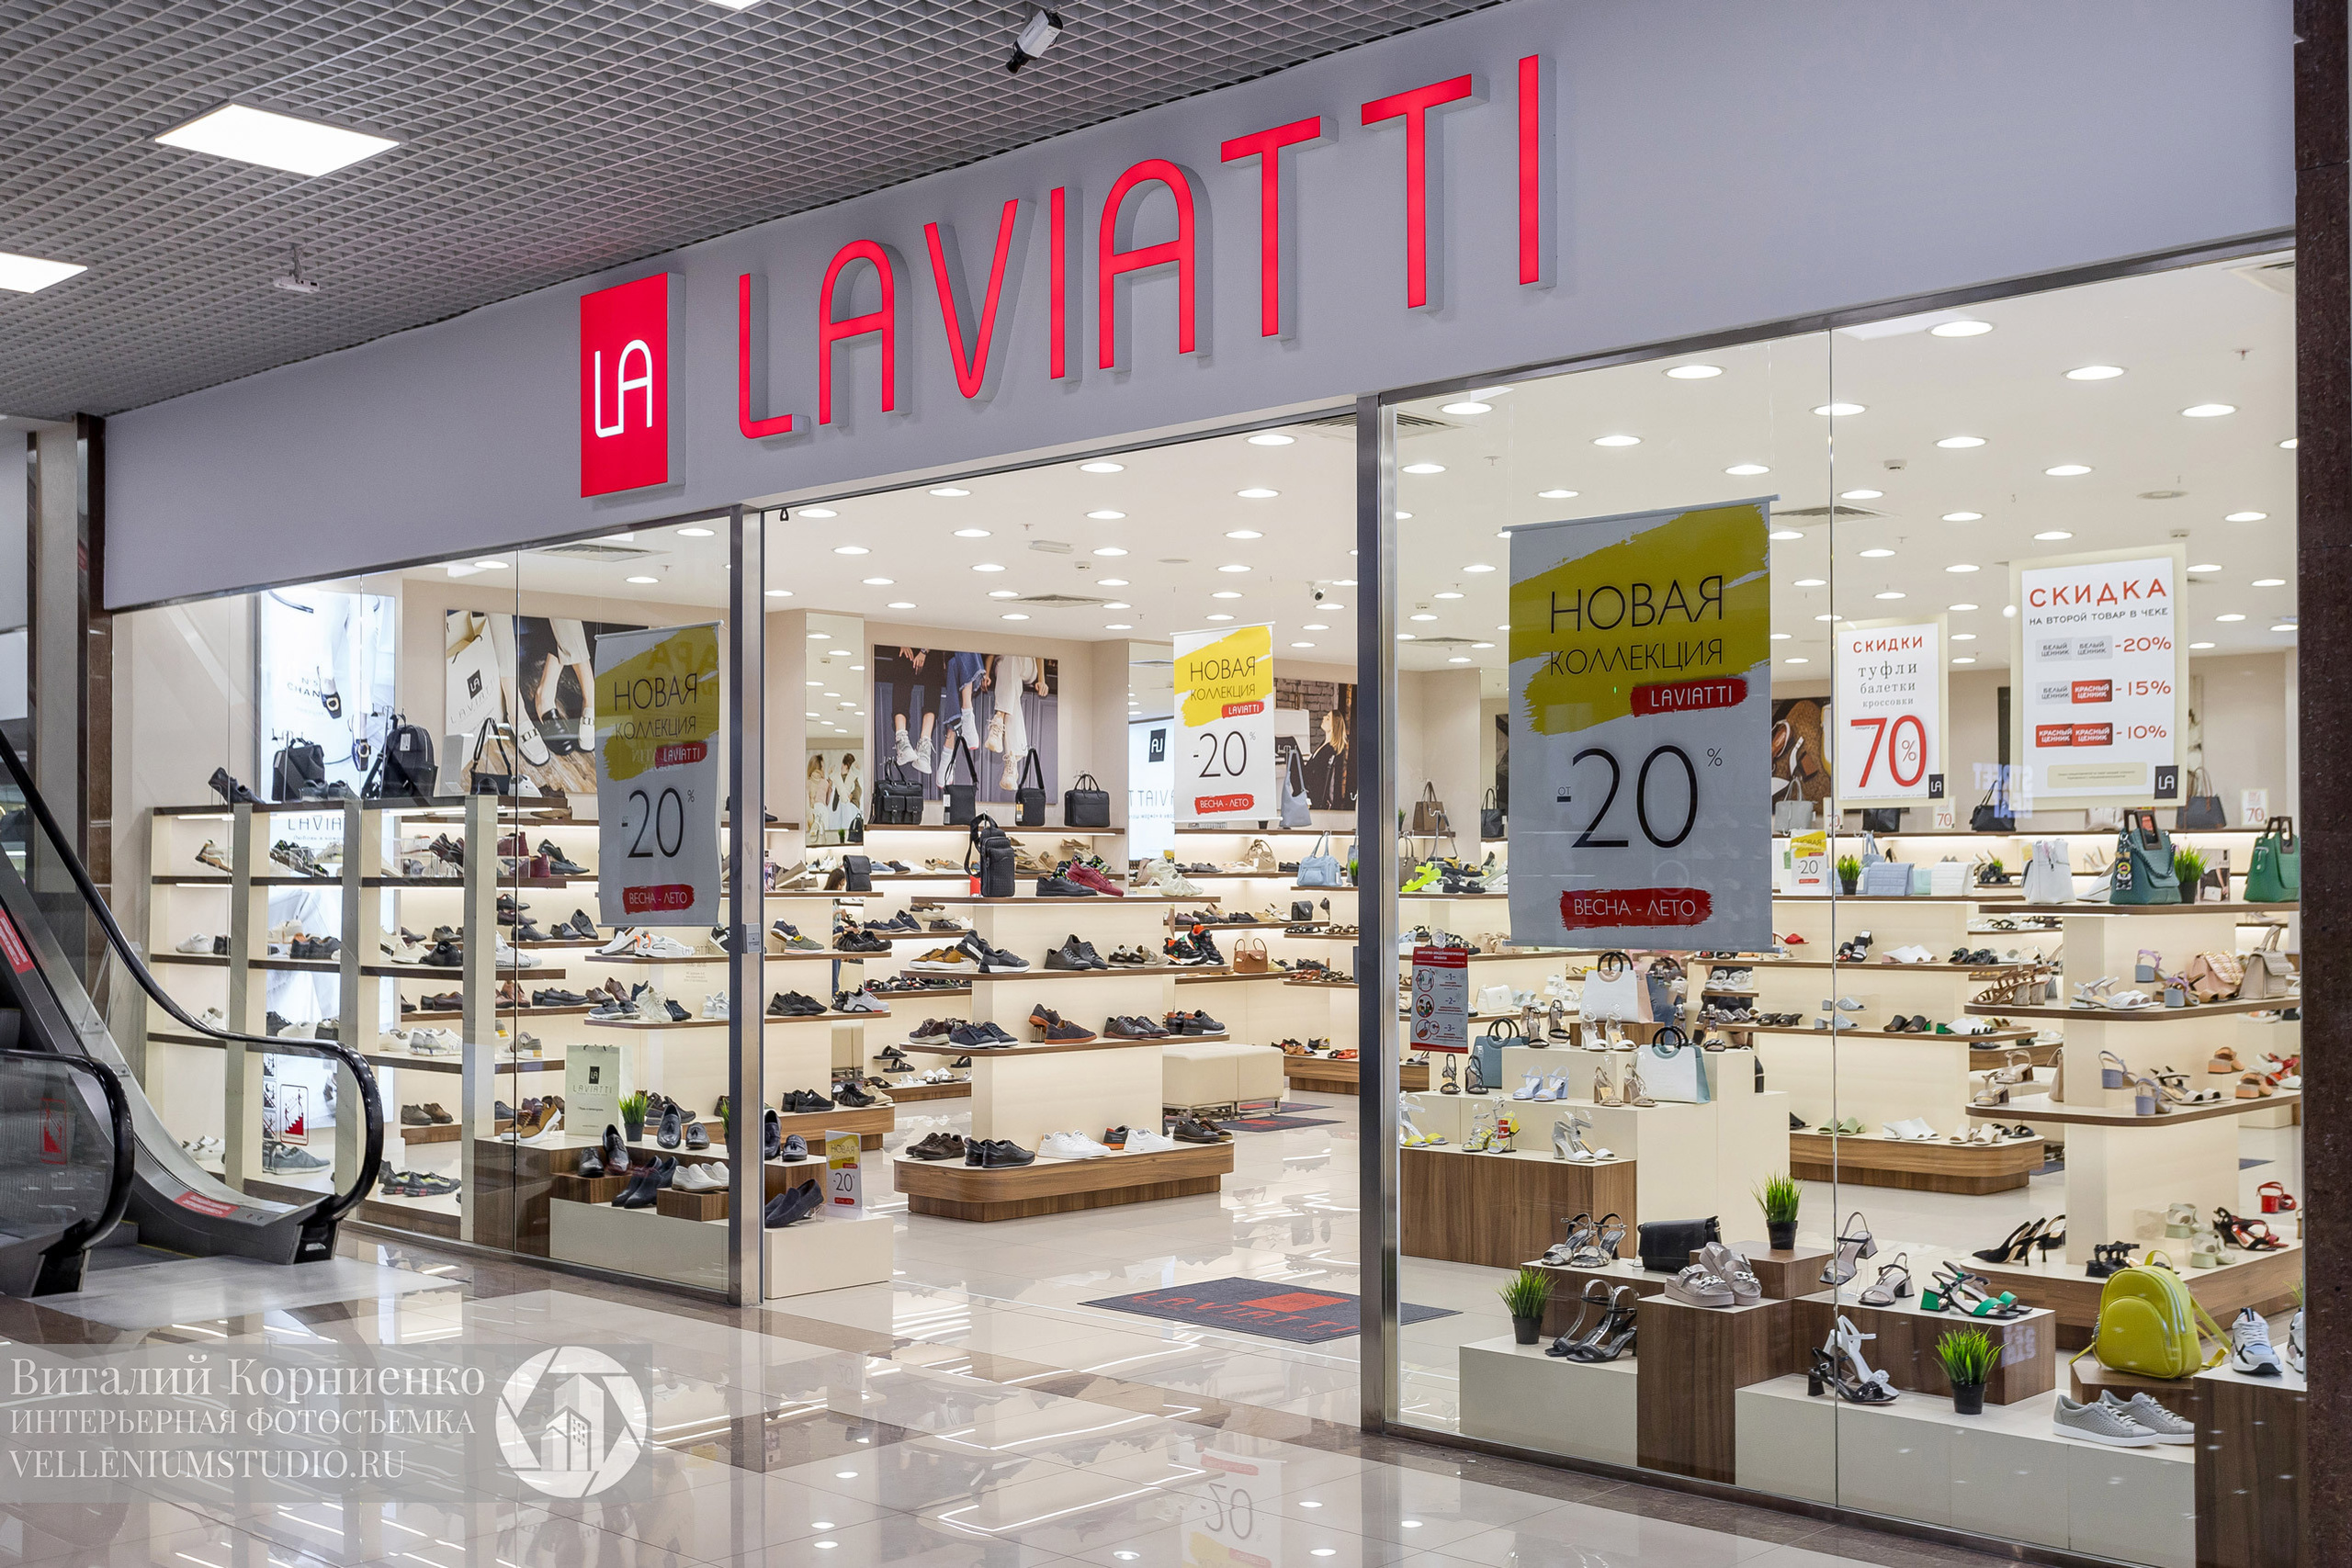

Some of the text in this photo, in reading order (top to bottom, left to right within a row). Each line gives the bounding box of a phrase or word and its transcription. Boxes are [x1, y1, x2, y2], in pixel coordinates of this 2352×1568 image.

[740, 54, 1541, 440] LAVIATTI
[594, 339, 653, 438] LA
[2029, 578, 2167, 608] СКИДКА
[1550, 574, 1724, 634] НОВАЯ
[2029, 607, 2168, 626] НА ВТОРОЙ ТОВАР В ЧЕКЕ
[1852, 636, 1923, 654] СКИДКИ
[2115, 637, 2172, 652] -20%
[1550, 638, 1723, 676] КОЛЛЕКЦИЯ
[1190, 656, 1256, 682] НОВАЯ
[1858, 660, 1917, 681] туфли
[287, 682, 321, 698] CHAN
[614, 672, 697, 712] НОВАЯ
[1190, 683, 1256, 702] КОЛЛЕКЦИЯ
[1651, 685, 1733, 707] LAVIATTI
[1860, 682, 1917, 694] балетки
[2075, 683, 2109, 693] КРАСНЫЙ
[2115, 680, 2172, 696] -15%
[1227, 704, 1260, 716] LAVIATTI
[1862, 698, 1914, 709] кроссовки
[615, 716, 696, 740] КОЛЛЕКЦИЯ
[2075, 727, 2110, 736] КРАСНЫЙ
[2116, 725, 2167, 739] -10%
[662, 747, 701, 762] LAVIATTI
[1199, 799, 1224, 808] ВЕСНА
[1228, 798, 1250, 807] ЛЕТО
[628, 892, 657, 905] ВЕСНА
[663, 891, 688, 904] ЛЕТО
[1574, 898, 1632, 916] ВЕСНА
[1646, 899, 1696, 917] ЛЕТО
[572, 1085, 612, 1094] LAVIATTI
[1132, 1292, 1360, 1334] LAVIATTI
